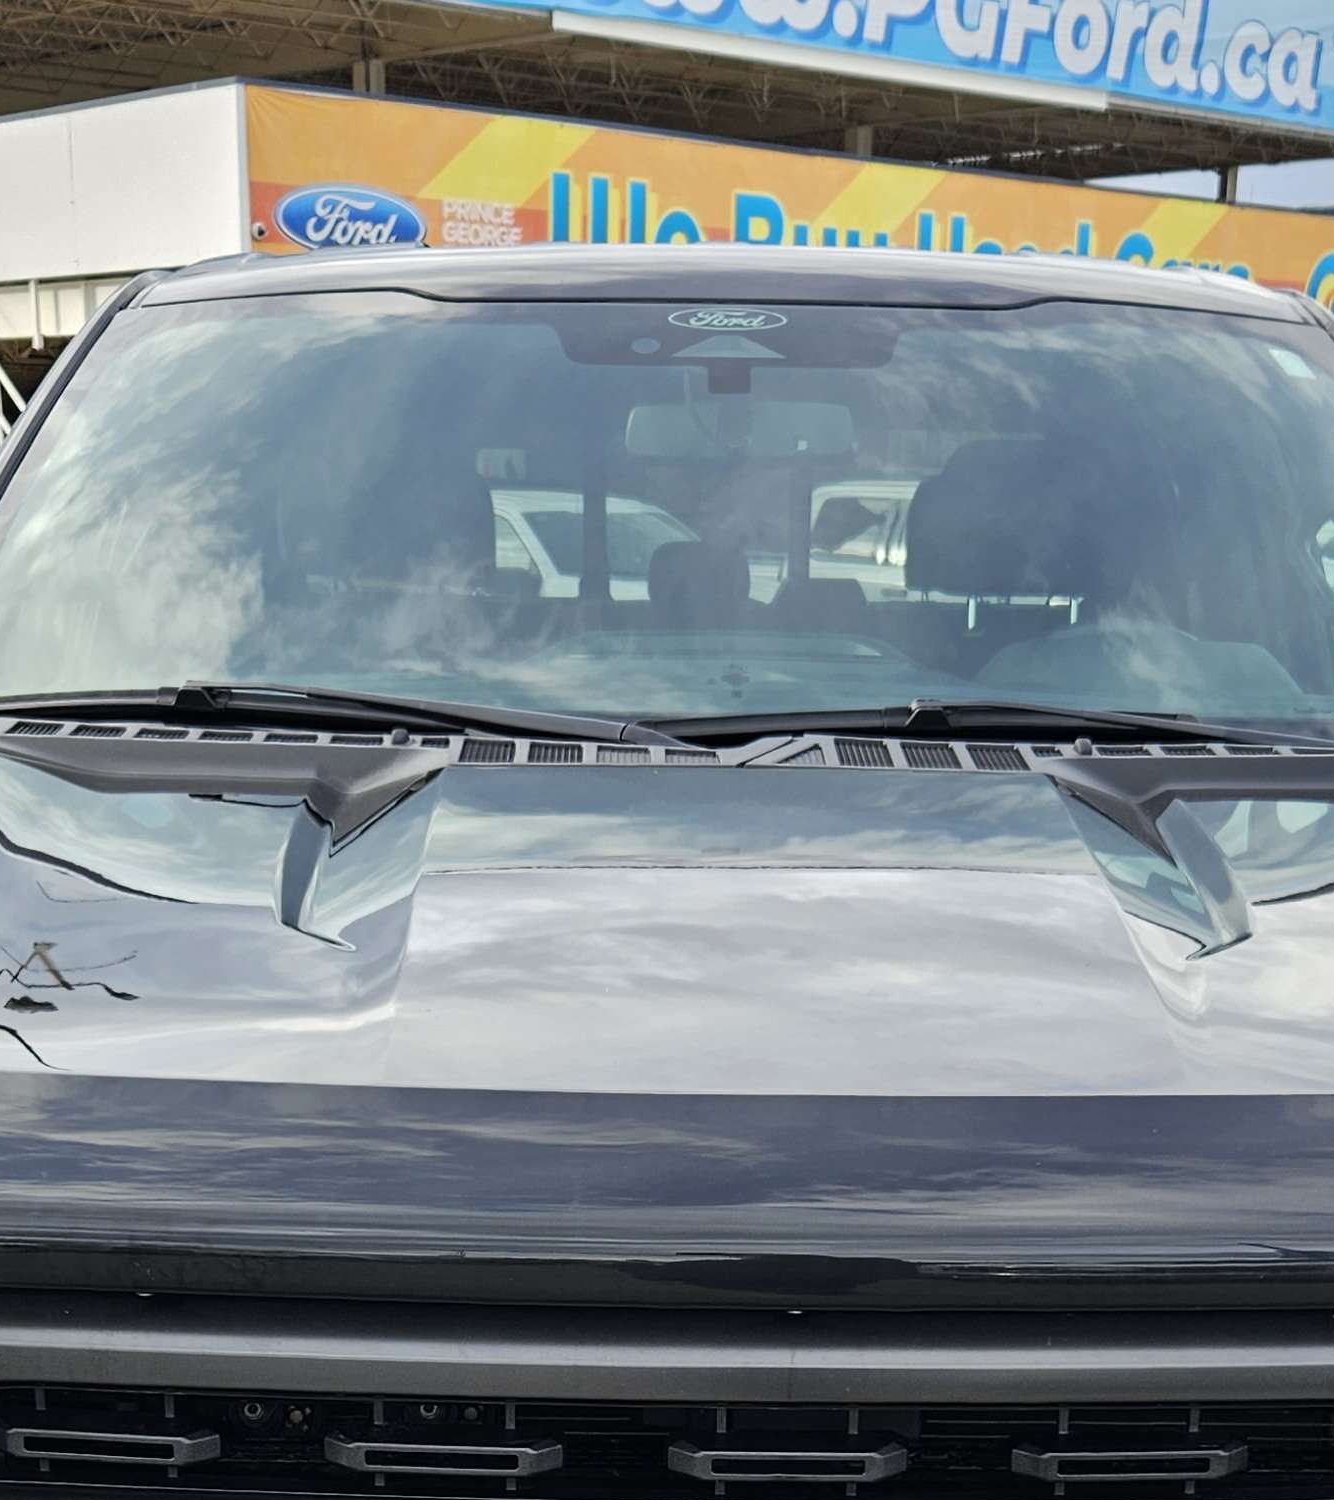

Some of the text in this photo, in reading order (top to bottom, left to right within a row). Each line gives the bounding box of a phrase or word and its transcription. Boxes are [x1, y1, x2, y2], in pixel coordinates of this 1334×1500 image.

[306, 194, 397, 246] Ford
[443, 199, 515, 226] PRINCE
[443, 220, 523, 247] GEORGE
[689, 310, 766, 327] Ford
